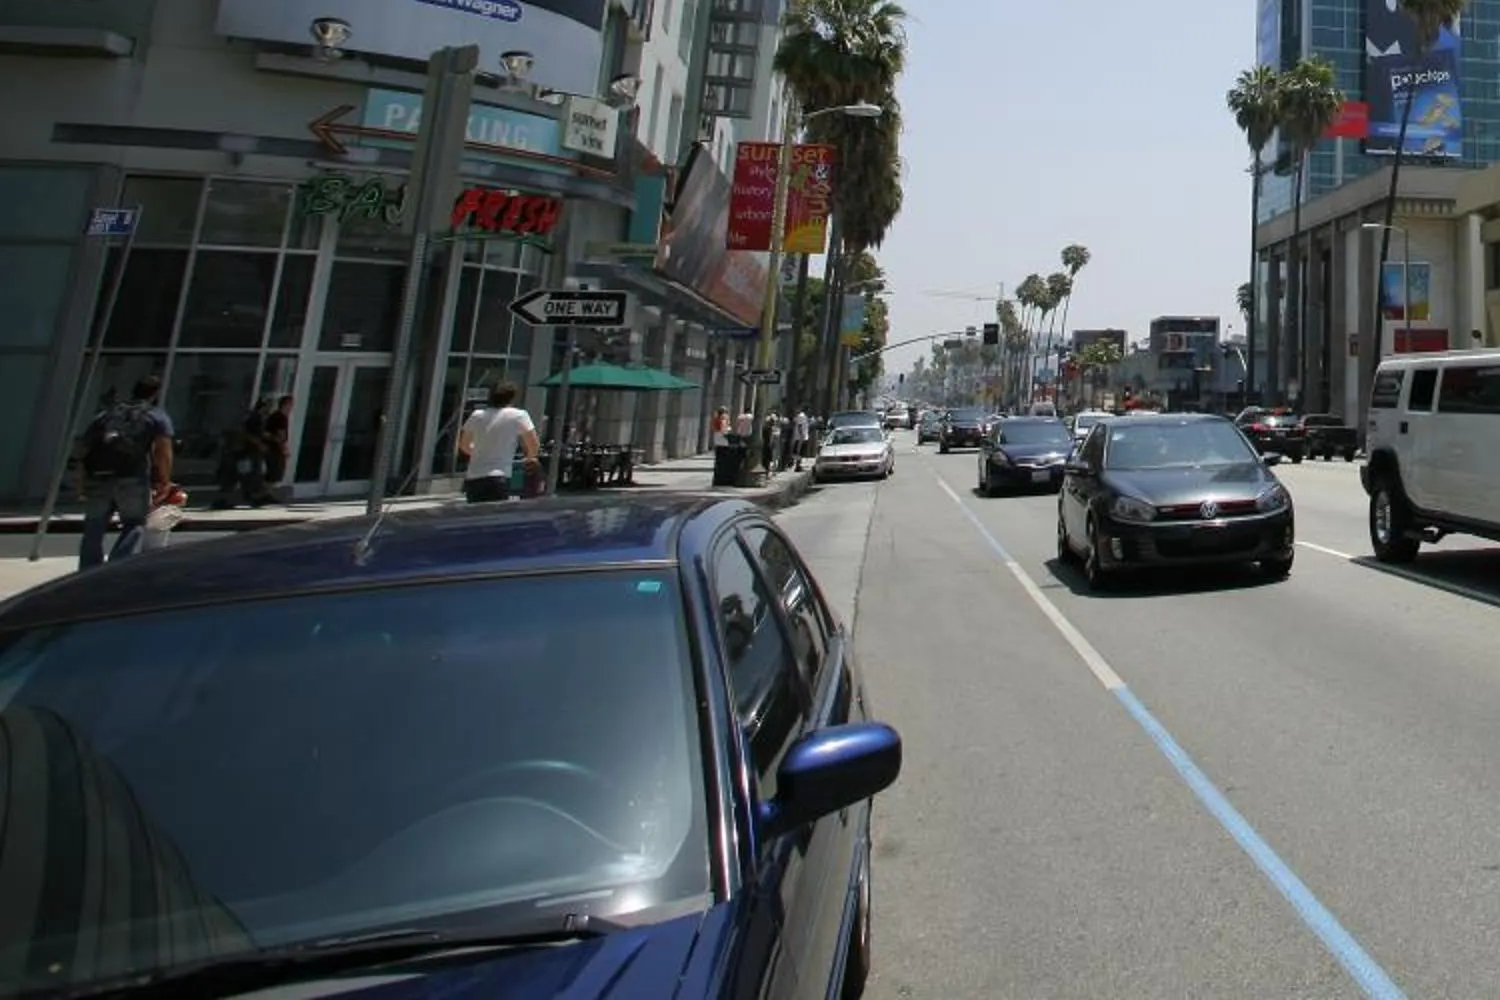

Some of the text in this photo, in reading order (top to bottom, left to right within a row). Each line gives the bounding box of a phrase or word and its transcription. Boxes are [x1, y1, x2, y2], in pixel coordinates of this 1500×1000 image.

[303, 177, 409, 225] BAJ
[450, 187, 563, 236] FRESH
[543, 300, 613, 315] ONE WAY
